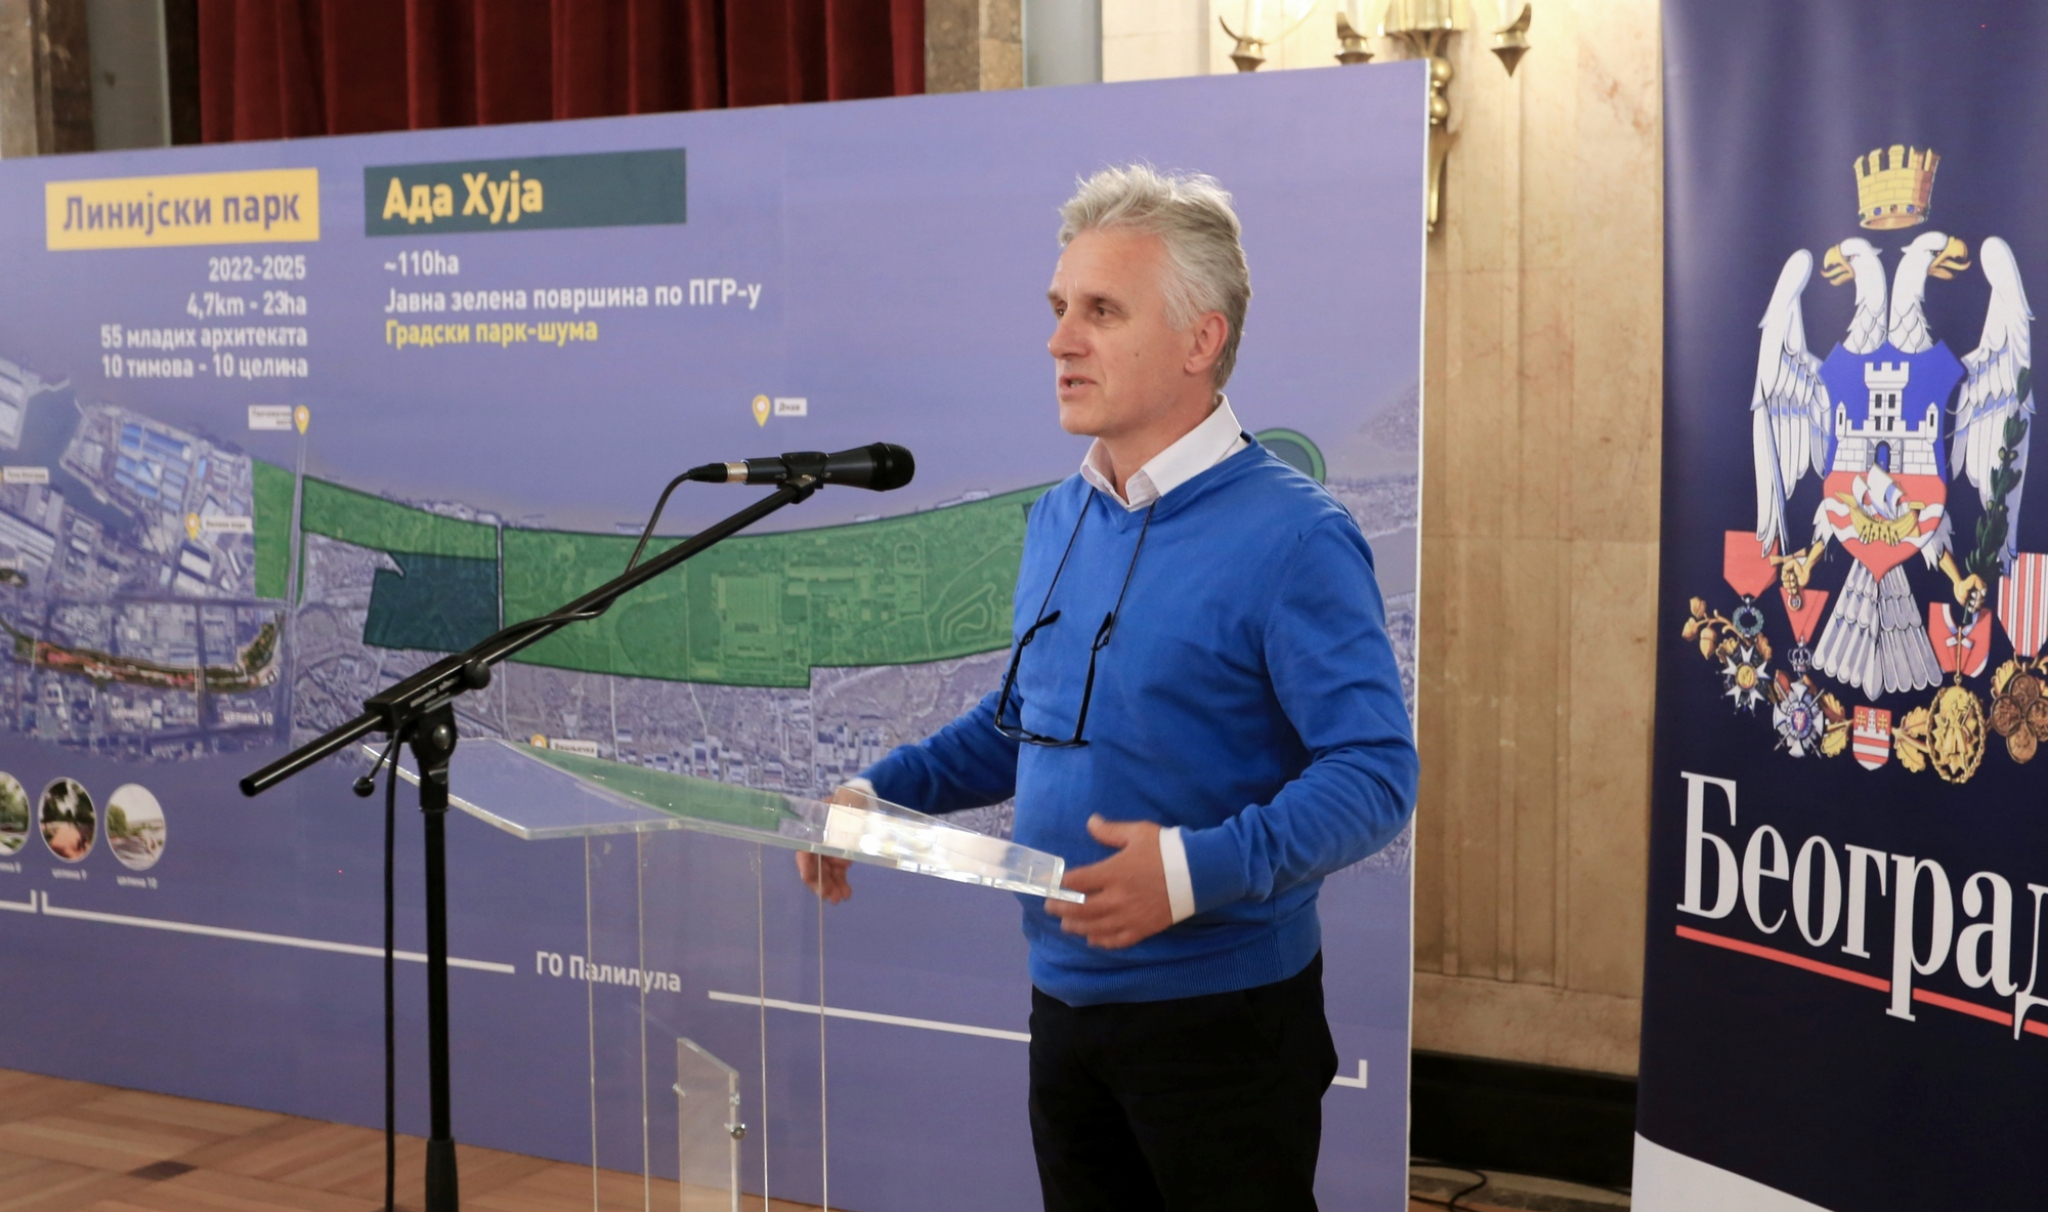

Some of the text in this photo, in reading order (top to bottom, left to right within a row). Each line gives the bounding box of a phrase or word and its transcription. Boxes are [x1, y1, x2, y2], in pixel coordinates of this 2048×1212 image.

[382, 170, 544, 224] Ада Хуја
[63, 190, 301, 237] Линијски парк
[208, 255, 306, 283] 2022-2025
[384, 250, 460, 277] ~110ha
[186, 292, 245, 320] 4,7km
[263, 290, 307, 316] 23ha
[385, 278, 762, 314] Јавна зелена површина по ПГР-у
[101, 324, 308, 352] 55 младих архитеката
[385, 318, 599, 350] Градски парк-шума
[102, 354, 122, 378] 10
[126, 356, 194, 378] тимова
[213, 352, 234, 378] 10
[239, 356, 308, 381] целина
[536, 950, 682, 994] ГО Палилула
